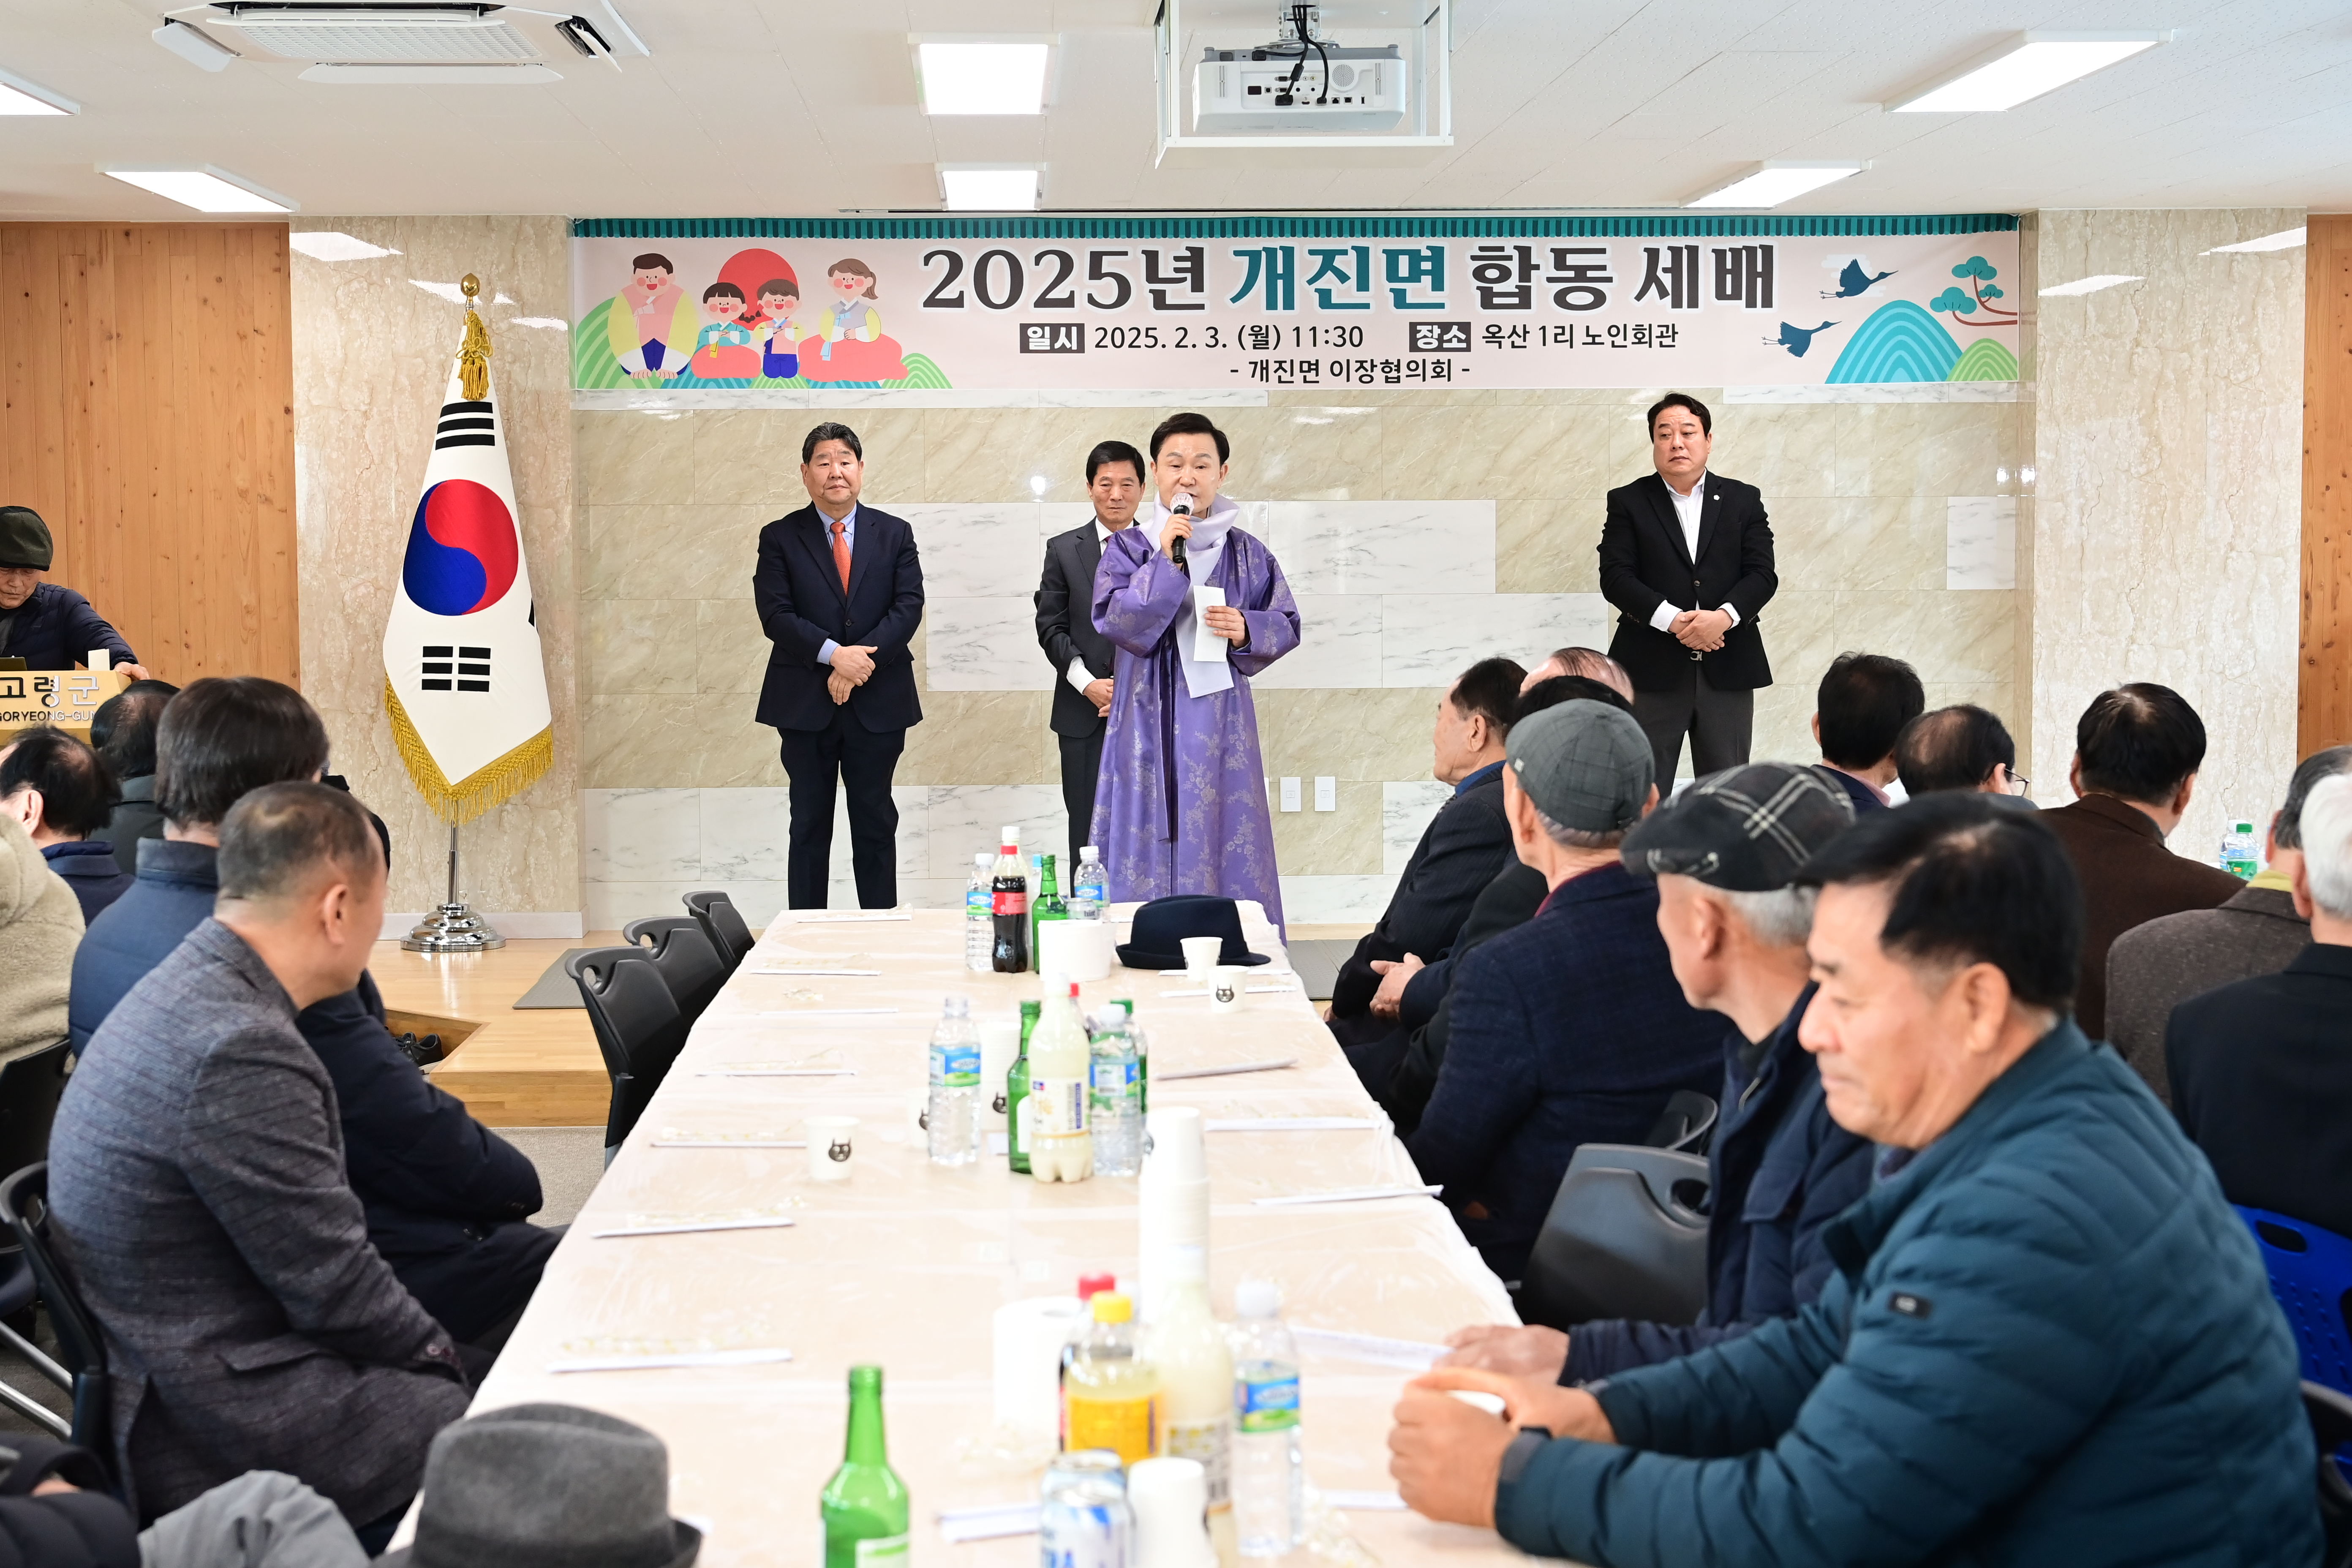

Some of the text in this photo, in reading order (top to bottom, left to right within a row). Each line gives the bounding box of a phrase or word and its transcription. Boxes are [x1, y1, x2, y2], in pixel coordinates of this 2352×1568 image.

[923, 244, 1774, 311] 2025년 개진면 합동 세배
[1027, 324, 1364, 351] 일시 2025. 2. 3. (월) 11:30
[1416, 323, 1679, 350] 장소 옥산 1리 노인회관
[1248, 359, 1320, 384] 개진면
[1329, 358, 1451, 384] 이장협의회
[0, 675, 100, 708] 고령군
[0, 710, 95, 721] ORYEONG-GU
